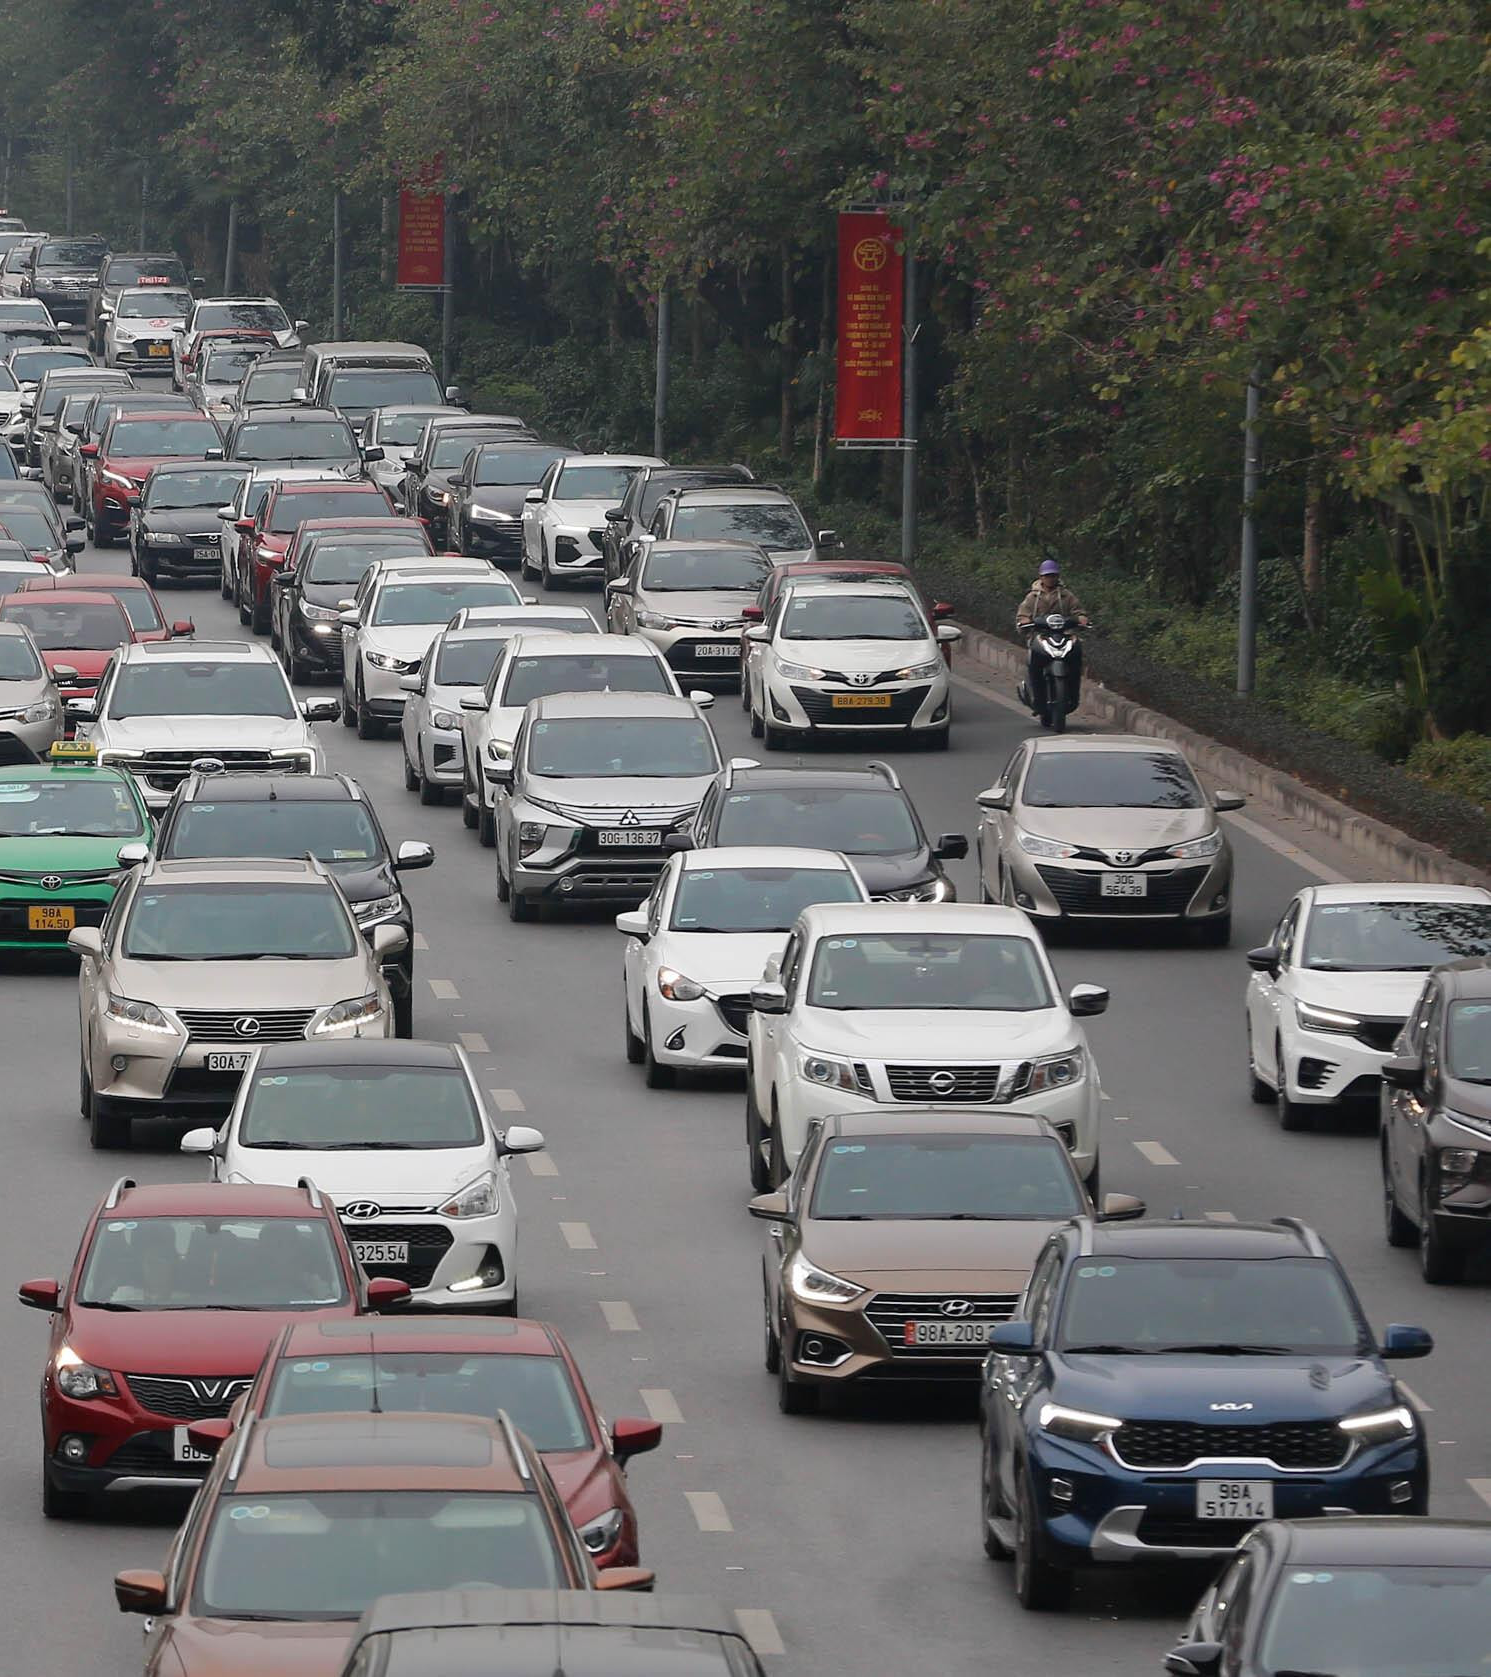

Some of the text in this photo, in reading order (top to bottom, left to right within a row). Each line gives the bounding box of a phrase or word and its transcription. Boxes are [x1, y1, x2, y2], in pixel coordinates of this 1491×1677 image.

[600, 832, 659, 844] 30G-136.37
[42, 908, 61, 918] 98A
[35, 919, 70, 928] 114.50
[211, 1055, 251, 1069] 30A-7
[356, 1245, 406, 1261] 325.54
[918, 1324, 996, 1342] 98A-209.
[1219, 1484, 1251, 1499] 98A
[1206, 1501, 1264, 1516] 517.14
